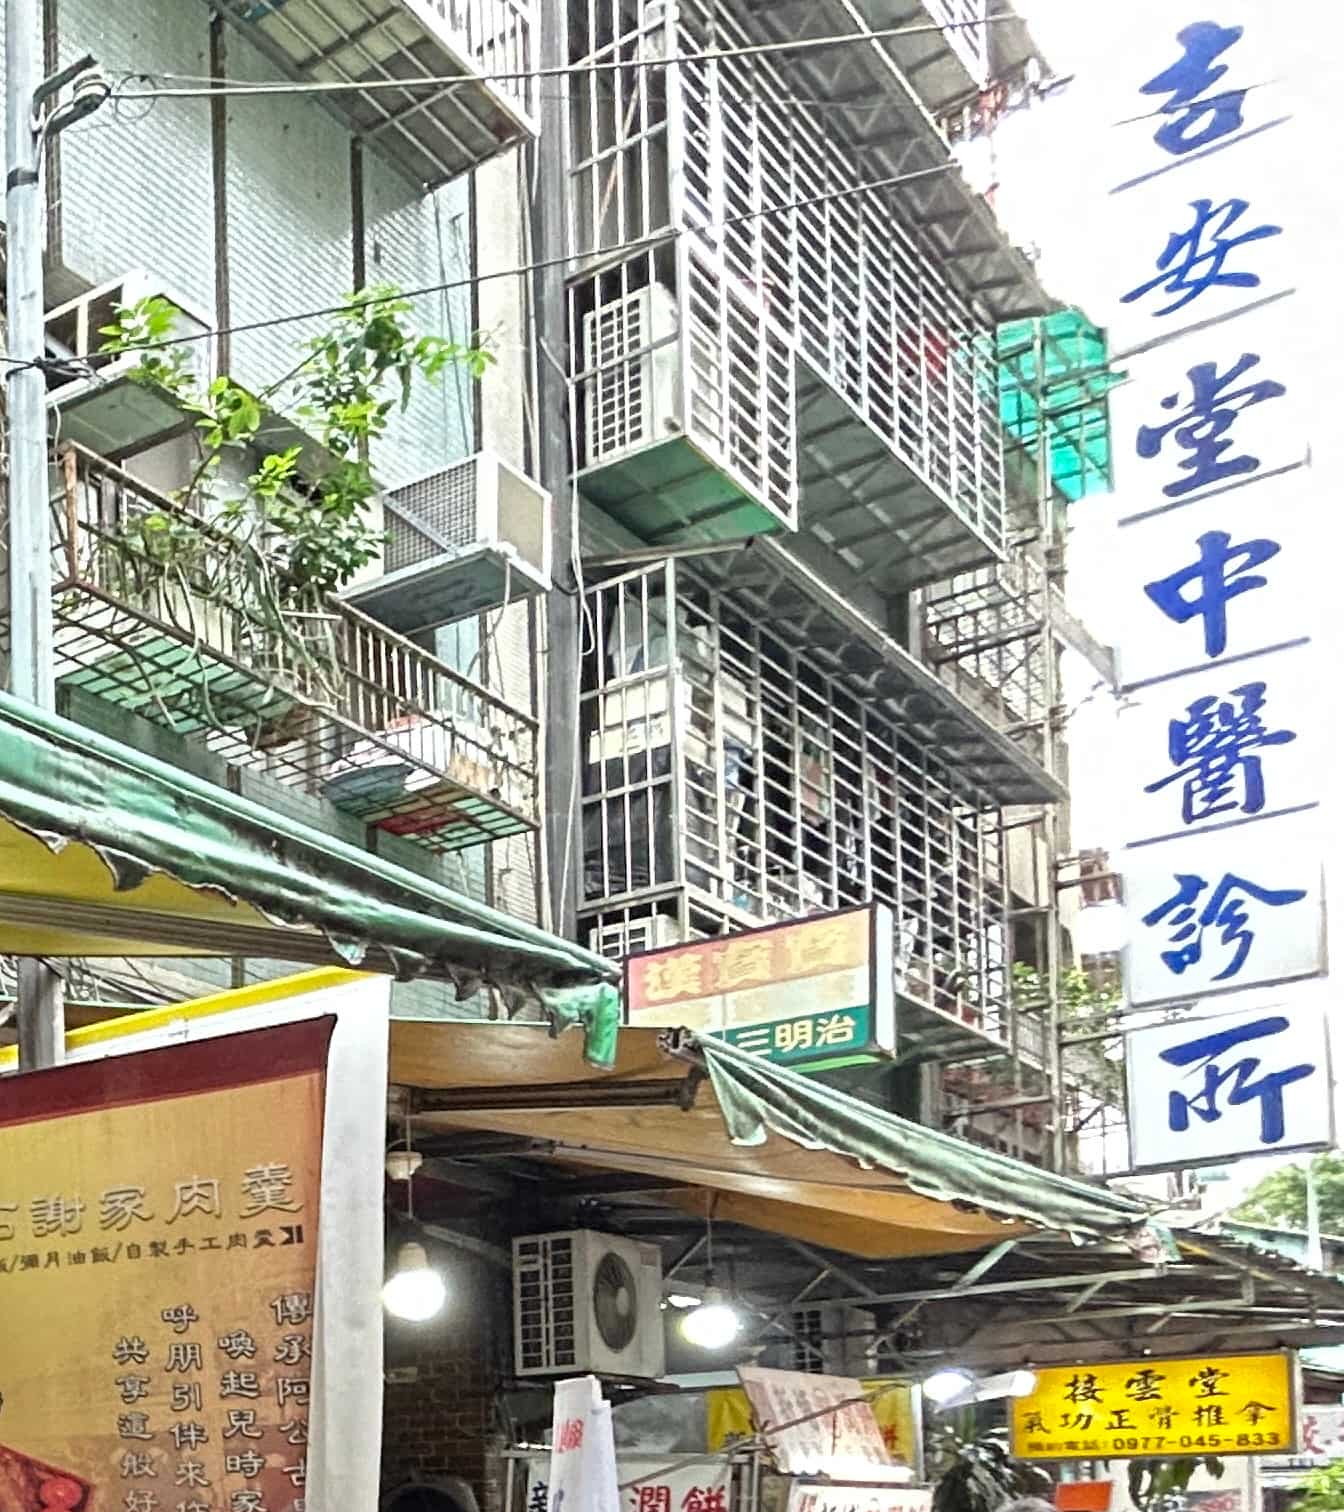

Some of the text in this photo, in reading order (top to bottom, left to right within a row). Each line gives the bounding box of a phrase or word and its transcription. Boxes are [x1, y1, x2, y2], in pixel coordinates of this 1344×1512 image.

[1119, 20, 1315, 1145] 吉安堂中醫診所
[736, 1013, 856, 1057] 三明治
[1064, 1365, 1235, 1405] 接雲堂
[1112, 1431, 1281, 1451] 0977-045-833
